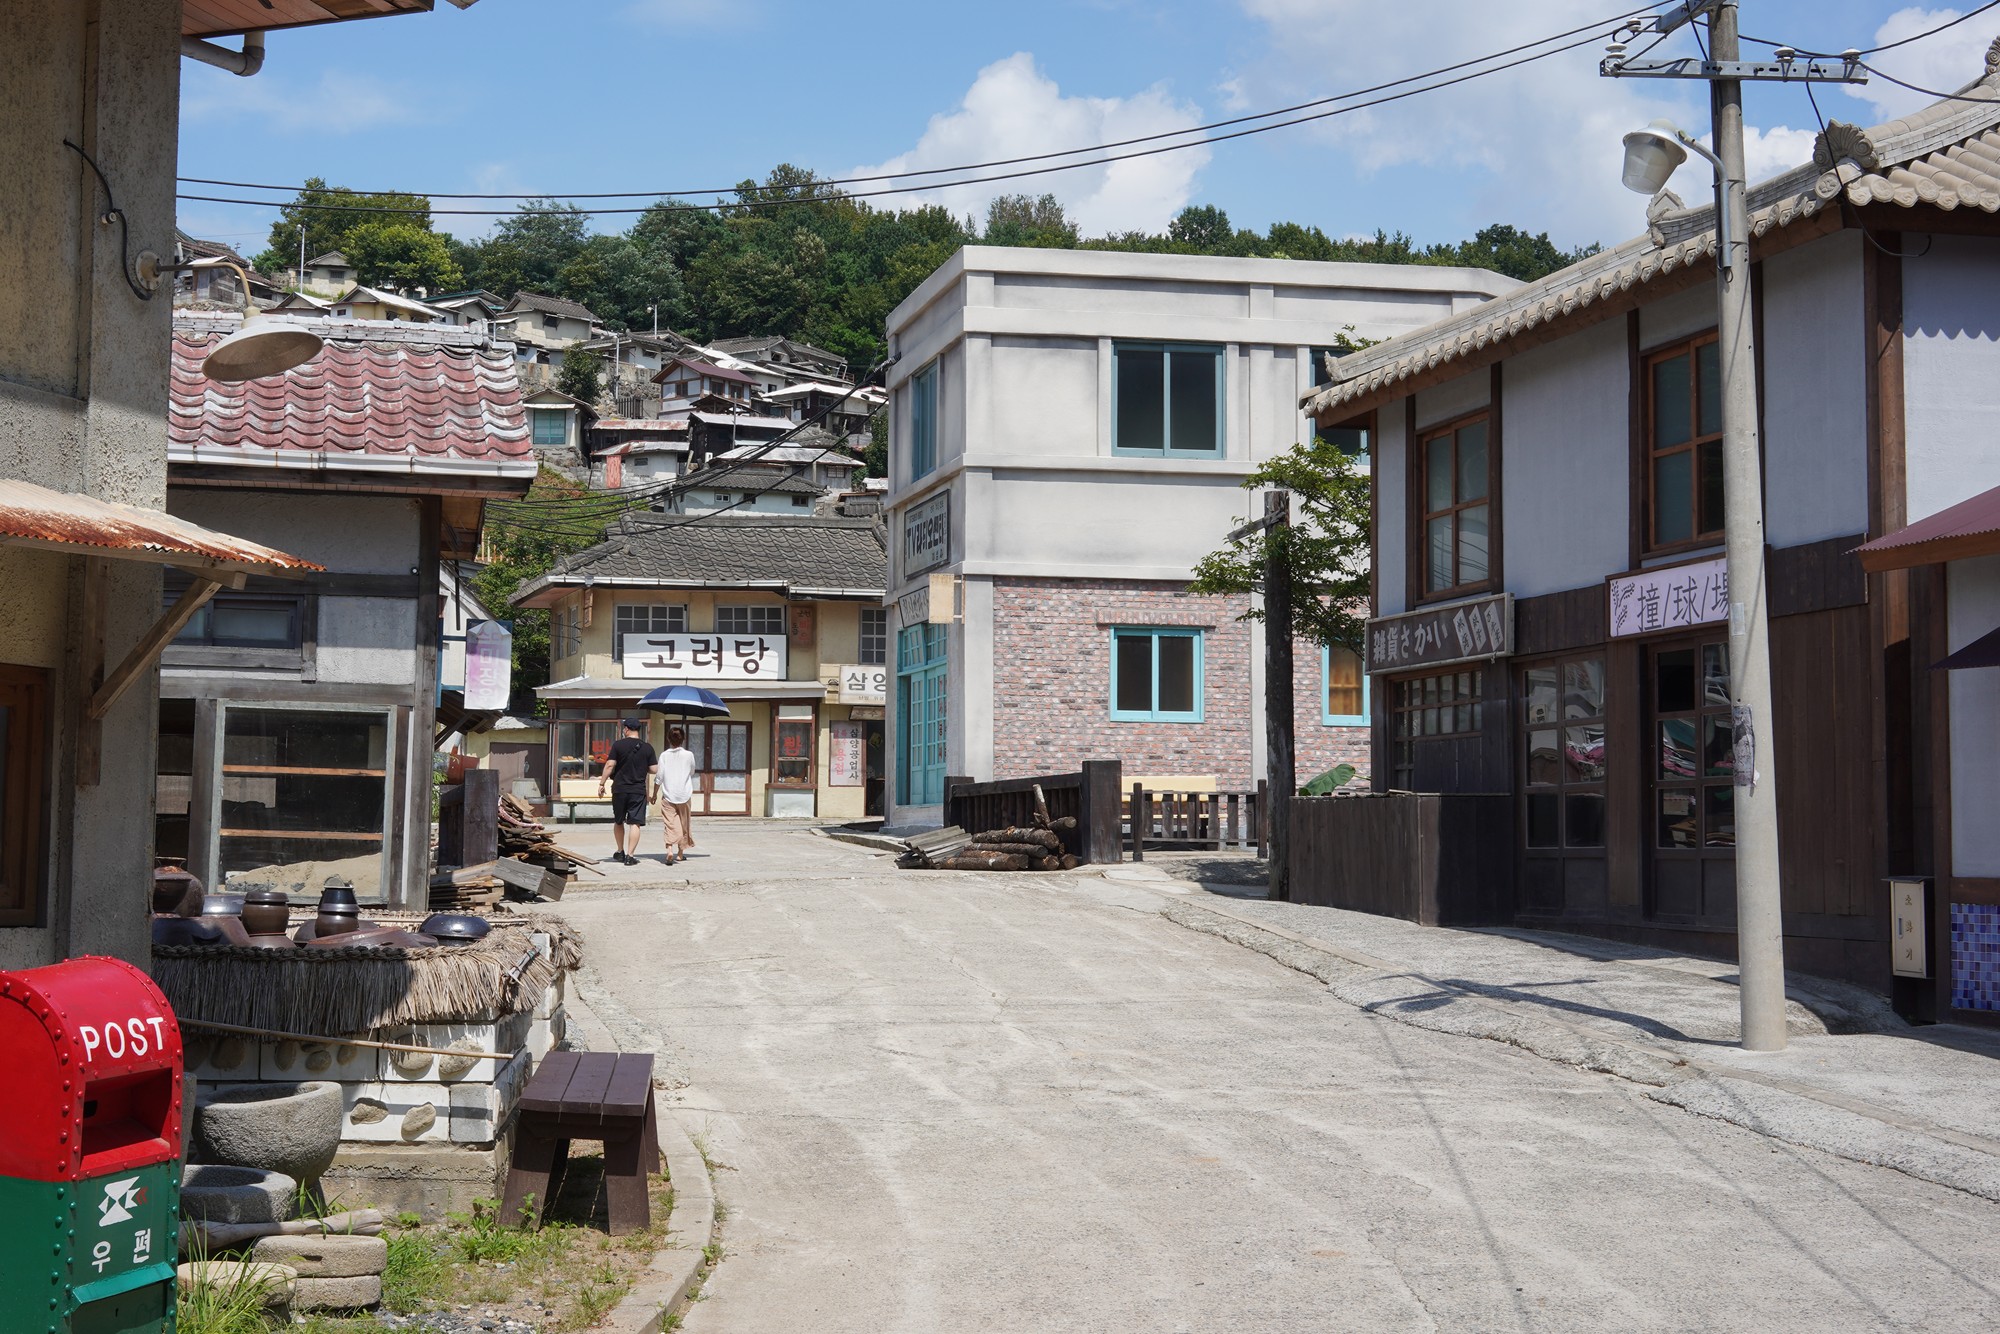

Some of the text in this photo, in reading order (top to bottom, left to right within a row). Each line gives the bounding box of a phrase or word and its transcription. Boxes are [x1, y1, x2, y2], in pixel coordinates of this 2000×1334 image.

[642, 637, 770, 674] 고려당
[849, 728, 860, 780] 삼양공업사
[79, 1016, 165, 1063] POST
[91, 1228, 151, 1273] 우편
